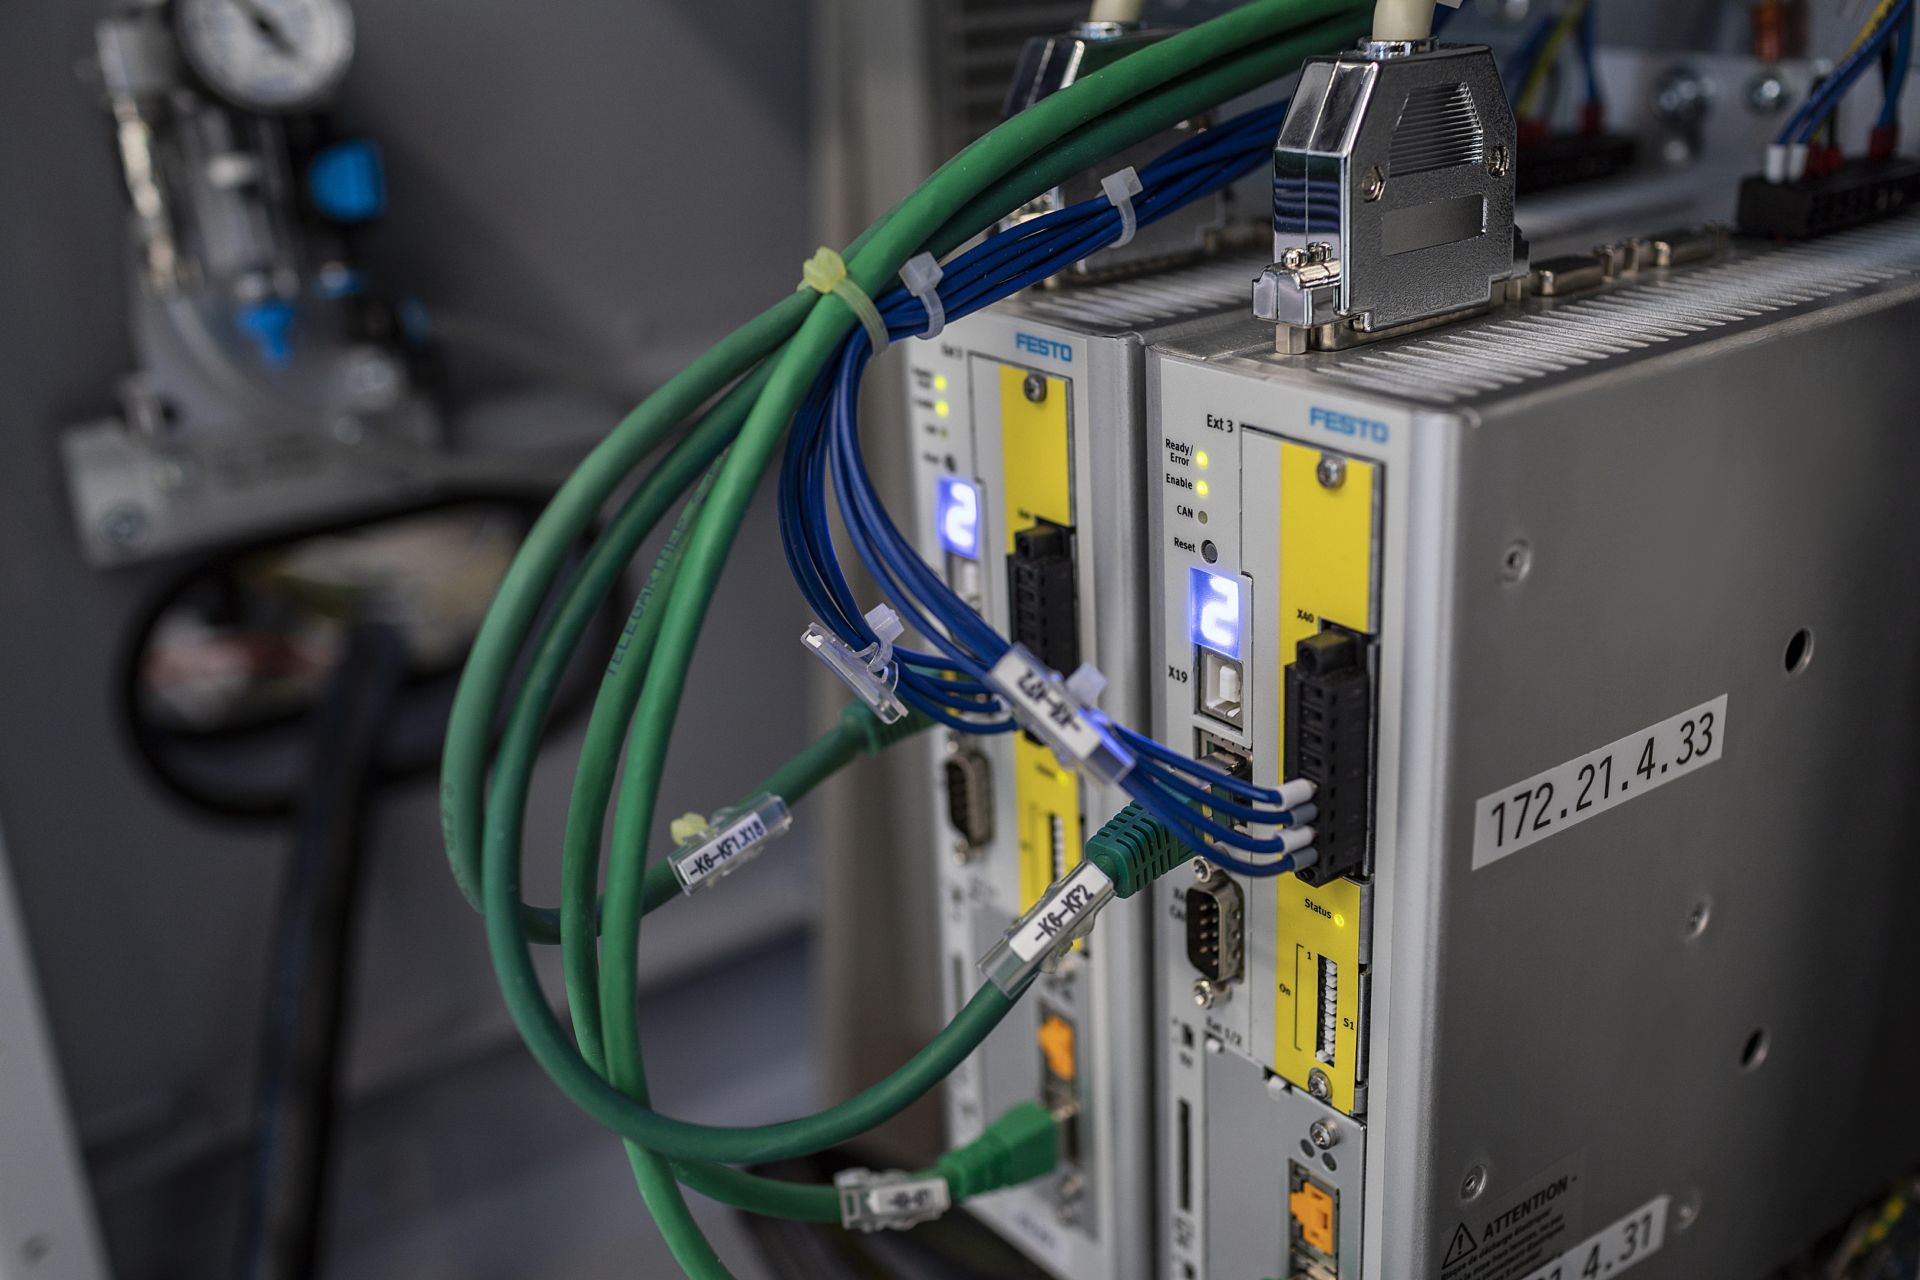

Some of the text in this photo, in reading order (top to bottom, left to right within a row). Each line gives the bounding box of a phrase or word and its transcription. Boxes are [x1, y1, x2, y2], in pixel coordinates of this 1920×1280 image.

[1016, 332, 1072, 363] FESTO
[1206, 414, 1234, 433] Ext 3
[1310, 406, 1390, 444] FESTO
[1165, 438, 1194, 457] Ready/
[1170, 452, 1190, 467] Error
[1166, 473, 1193, 491] Enable
[1177, 505, 1194, 519] CAN
[1174, 537, 1196, 553] Reset
[1201, 576, 1239, 647] 2
[1168, 665, 1188, 683] X19
[1491, 712, 1714, 848] 172.21.4.33
[1035, 884, 1094, 942] -K6-KF2
[1304, 898, 1332, 920] Status
[1343, 1017, 1354, 1031] S1
[1483, 1175, 1568, 1242] ATTENTION
